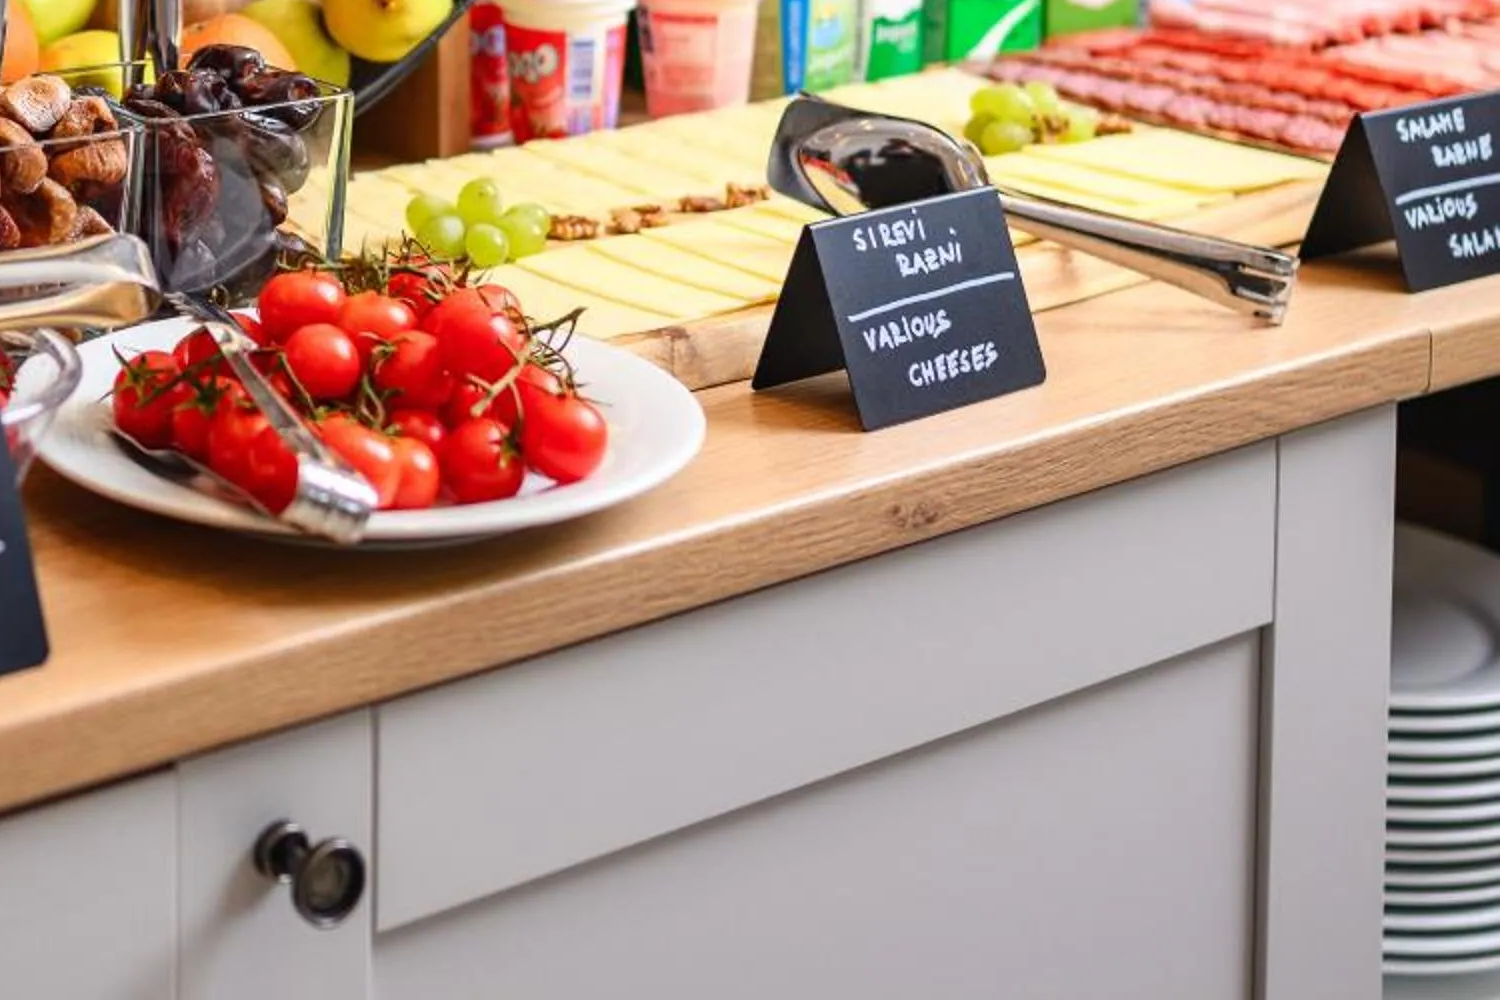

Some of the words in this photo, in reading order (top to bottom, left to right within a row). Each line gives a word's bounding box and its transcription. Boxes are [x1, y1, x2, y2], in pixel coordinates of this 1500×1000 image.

[1396, 106, 1466, 143] SALAME
[852, 207, 926, 252] SIREVI
[1404, 192, 1479, 231] VARIOUS
[863, 308, 952, 353] VARIOUS
[908, 341, 999, 387] CHEESES
